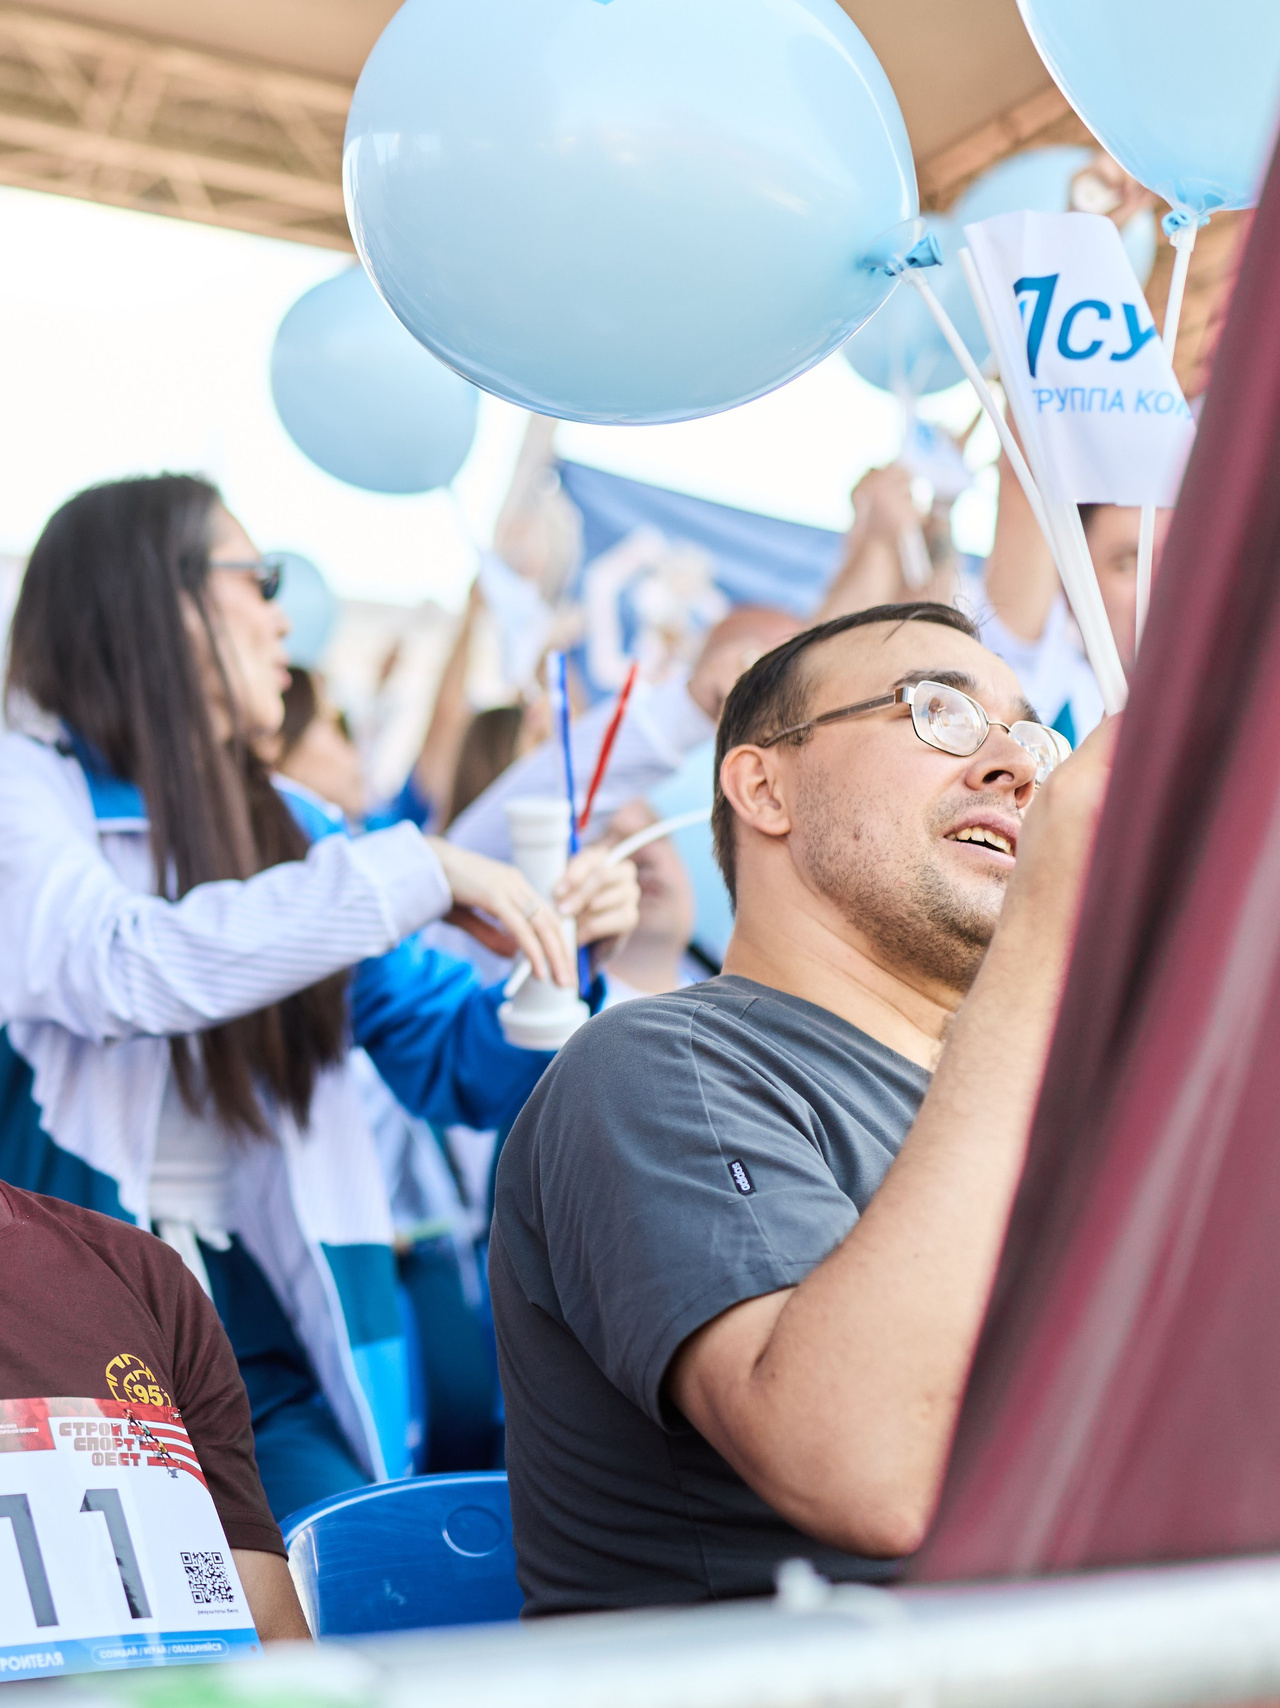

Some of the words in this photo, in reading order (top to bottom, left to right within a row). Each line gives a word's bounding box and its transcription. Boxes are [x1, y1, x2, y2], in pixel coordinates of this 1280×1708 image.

[1032, 387, 1126, 414] РУППА
[731, 1161, 751, 1191] adidas
[132, 1384, 164, 1407] 95
[73, 1437, 135, 1451] СПОРТ
[91, 1452, 141, 1467] ФЕСТ
